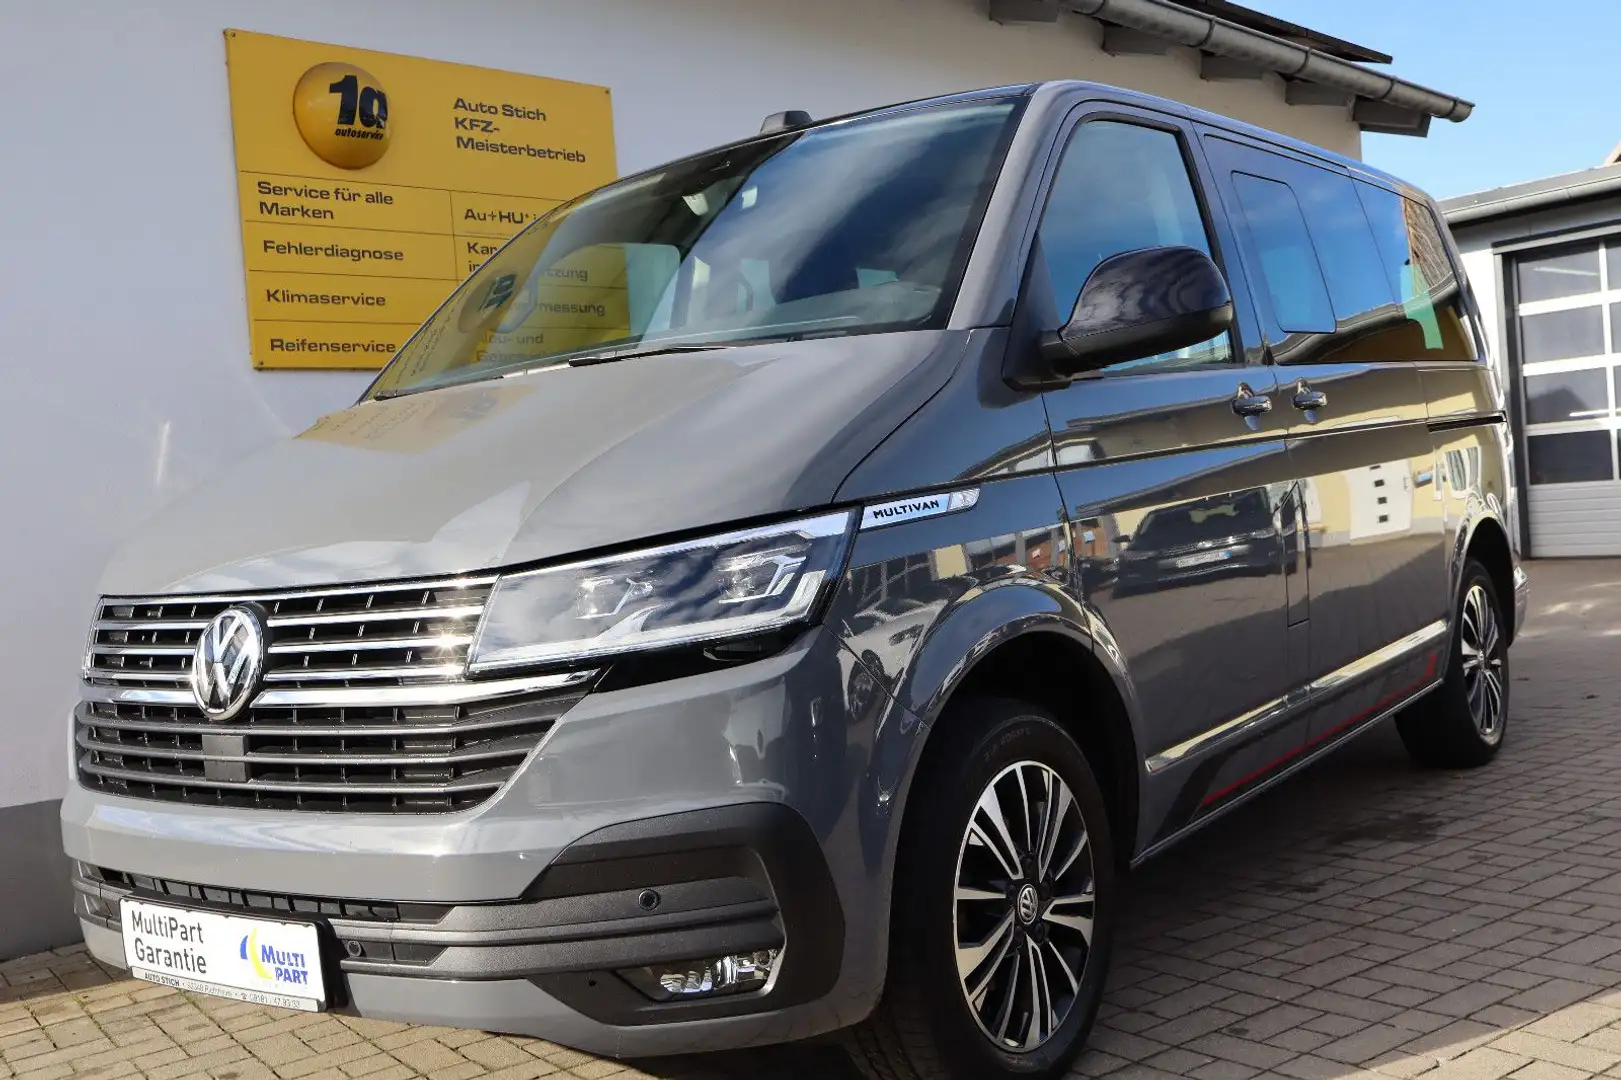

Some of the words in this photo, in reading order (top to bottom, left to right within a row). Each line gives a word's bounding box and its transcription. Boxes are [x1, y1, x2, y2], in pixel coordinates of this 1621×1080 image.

[453, 97, 498, 116] Auto
[501, 103, 547, 121] Stich
[335, 127, 384, 140] autoservice
[454, 117, 500, 134] KFZ-
[456, 136, 586, 163] Meisterbetrieb
[257, 181, 330, 200] Service
[333, 188, 361, 204] für
[364, 189, 393, 205] alle
[259, 202, 334, 220] Marken
[263, 239, 404, 262] Fehlerdiagnose
[266, 289, 386, 307] Klimaservice
[270, 338, 396, 354] Reifenservice
[873, 500, 939, 519] MULTIVAN
[132, 910, 204, 944] MultiPart
[134, 937, 207, 974] Garantie
[261, 944, 306, 968] MULTI
[144, 972, 161, 984] AUTO
[161, 975, 180, 987] STICH
[275, 967, 308, 985] PART
